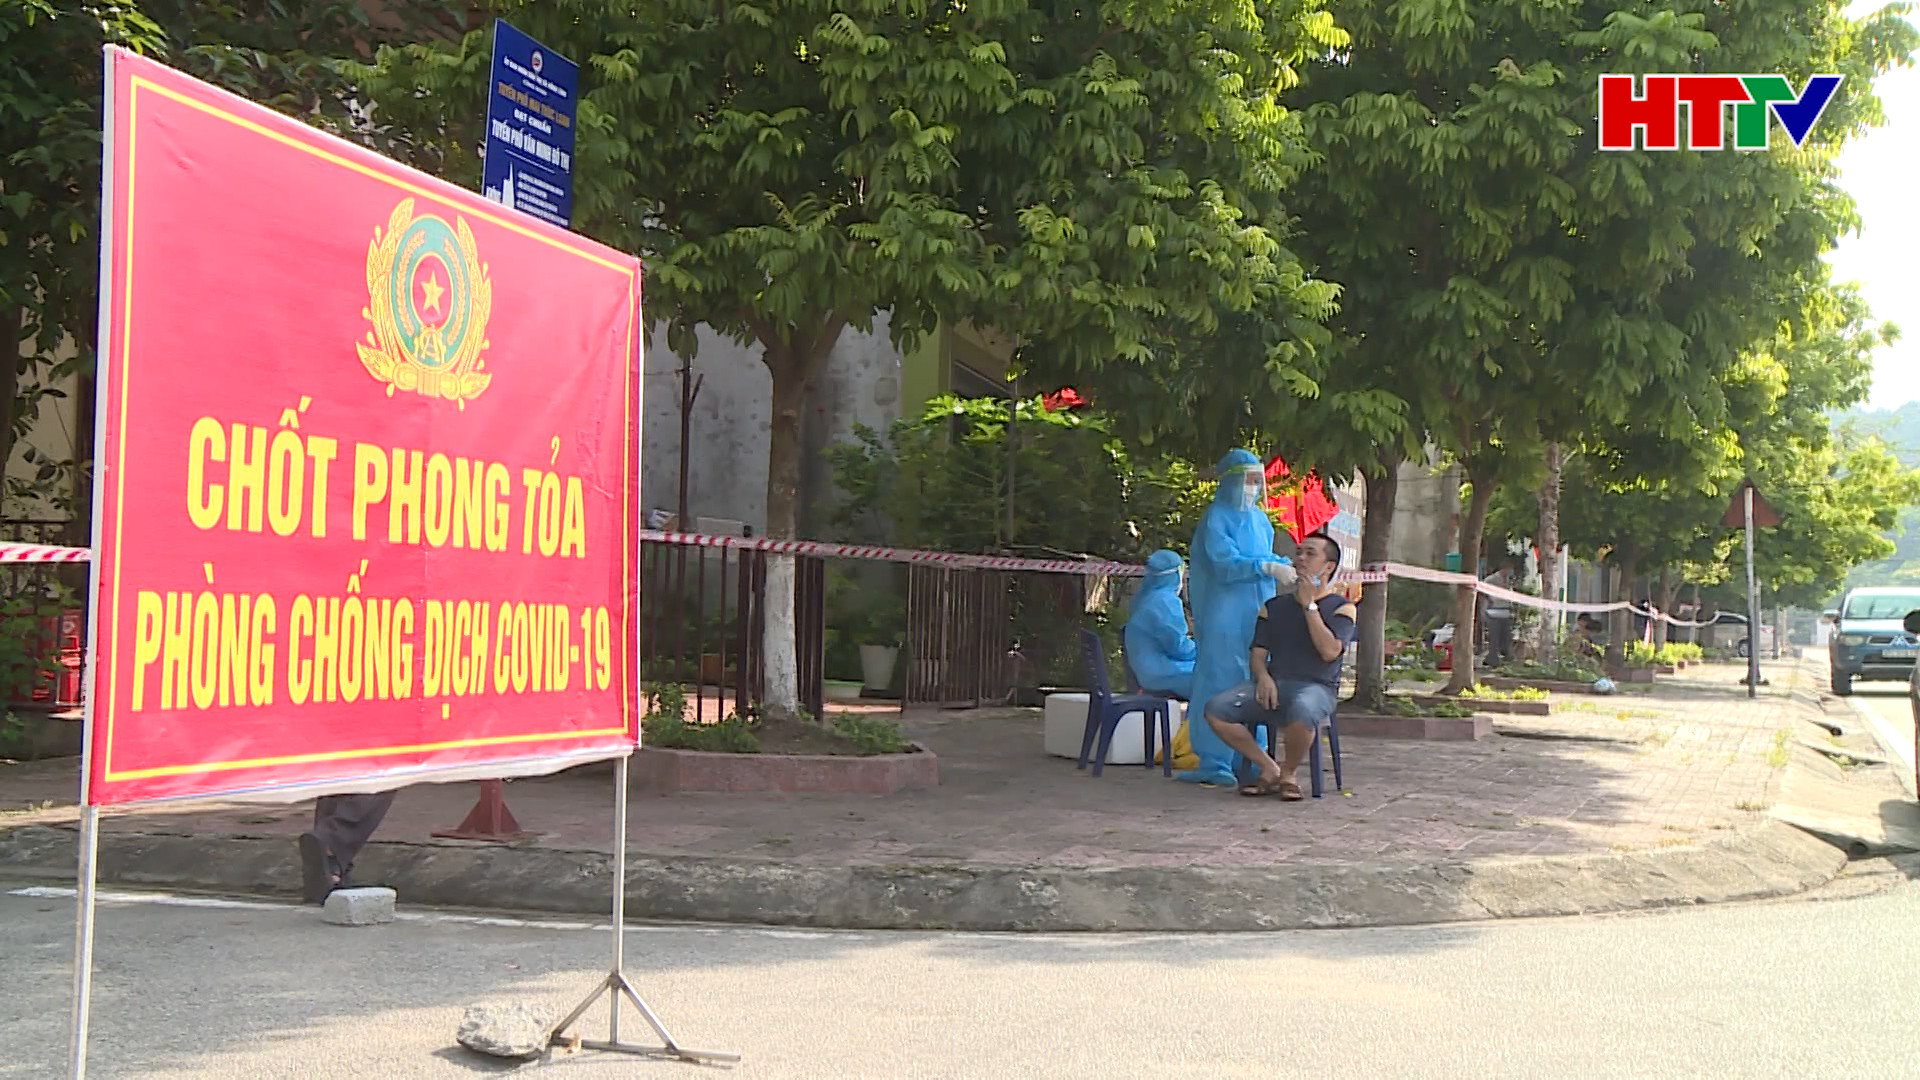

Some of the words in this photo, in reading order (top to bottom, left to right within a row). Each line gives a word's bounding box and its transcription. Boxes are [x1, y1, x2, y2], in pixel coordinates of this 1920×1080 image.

[188, 397, 337, 536] CHỐT
[353, 443, 509, 550] PHONG
[523, 437, 584, 557] TỎA
[133, 563, 275, 710] PHÒNG
[289, 560, 413, 703] CHỐNG
[424, 601, 488, 718] DỊCH
[494, 603, 610, 692] COVID-19
